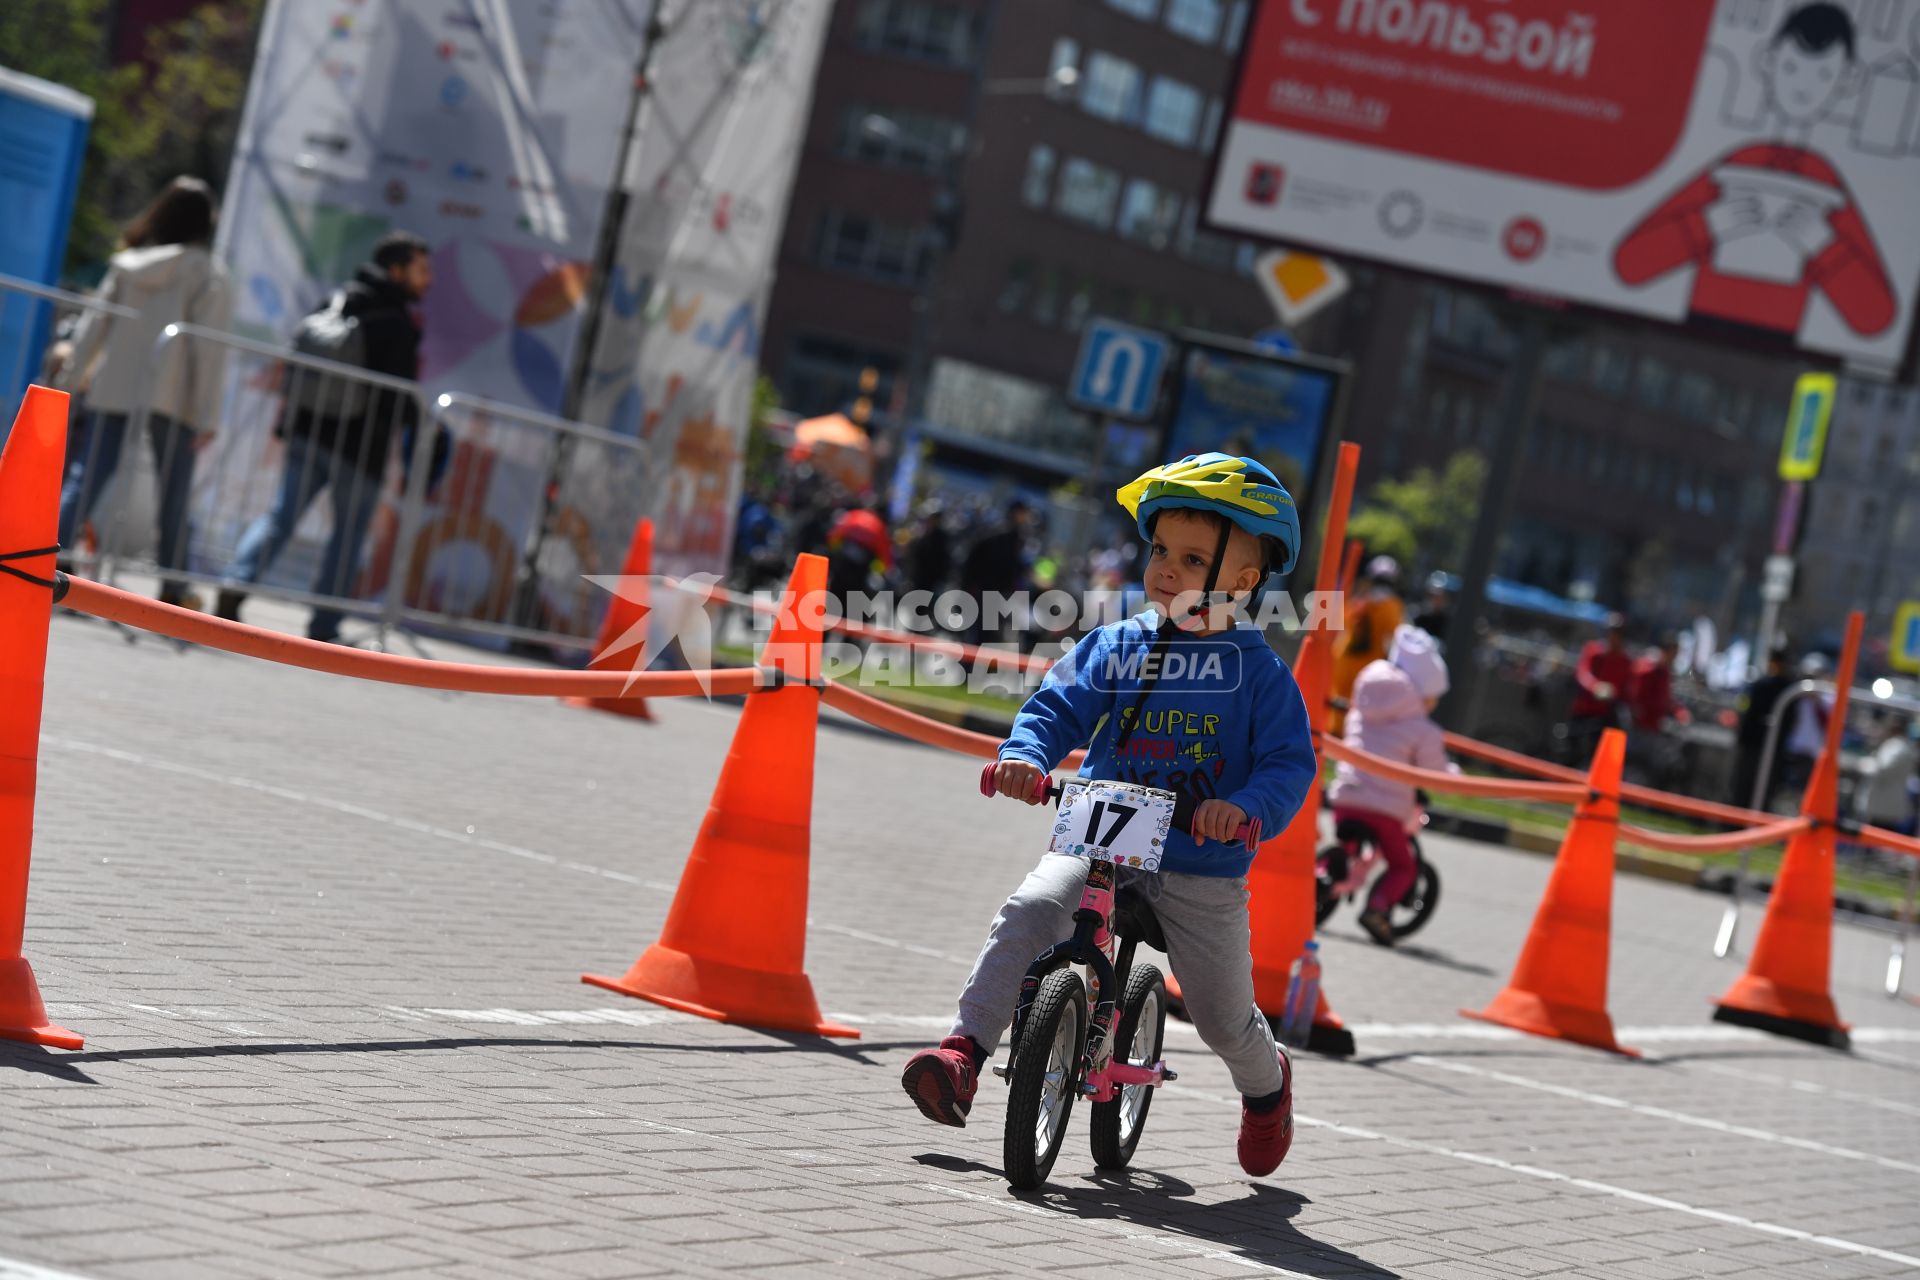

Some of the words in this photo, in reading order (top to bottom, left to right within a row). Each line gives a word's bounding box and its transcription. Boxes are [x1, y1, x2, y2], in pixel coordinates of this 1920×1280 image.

[1336, 0, 1597, 78] пользой
[1120, 706, 1220, 735] SUPER
[1176, 739, 1221, 760] MEGA
[1084, 801, 1138, 847] 17
